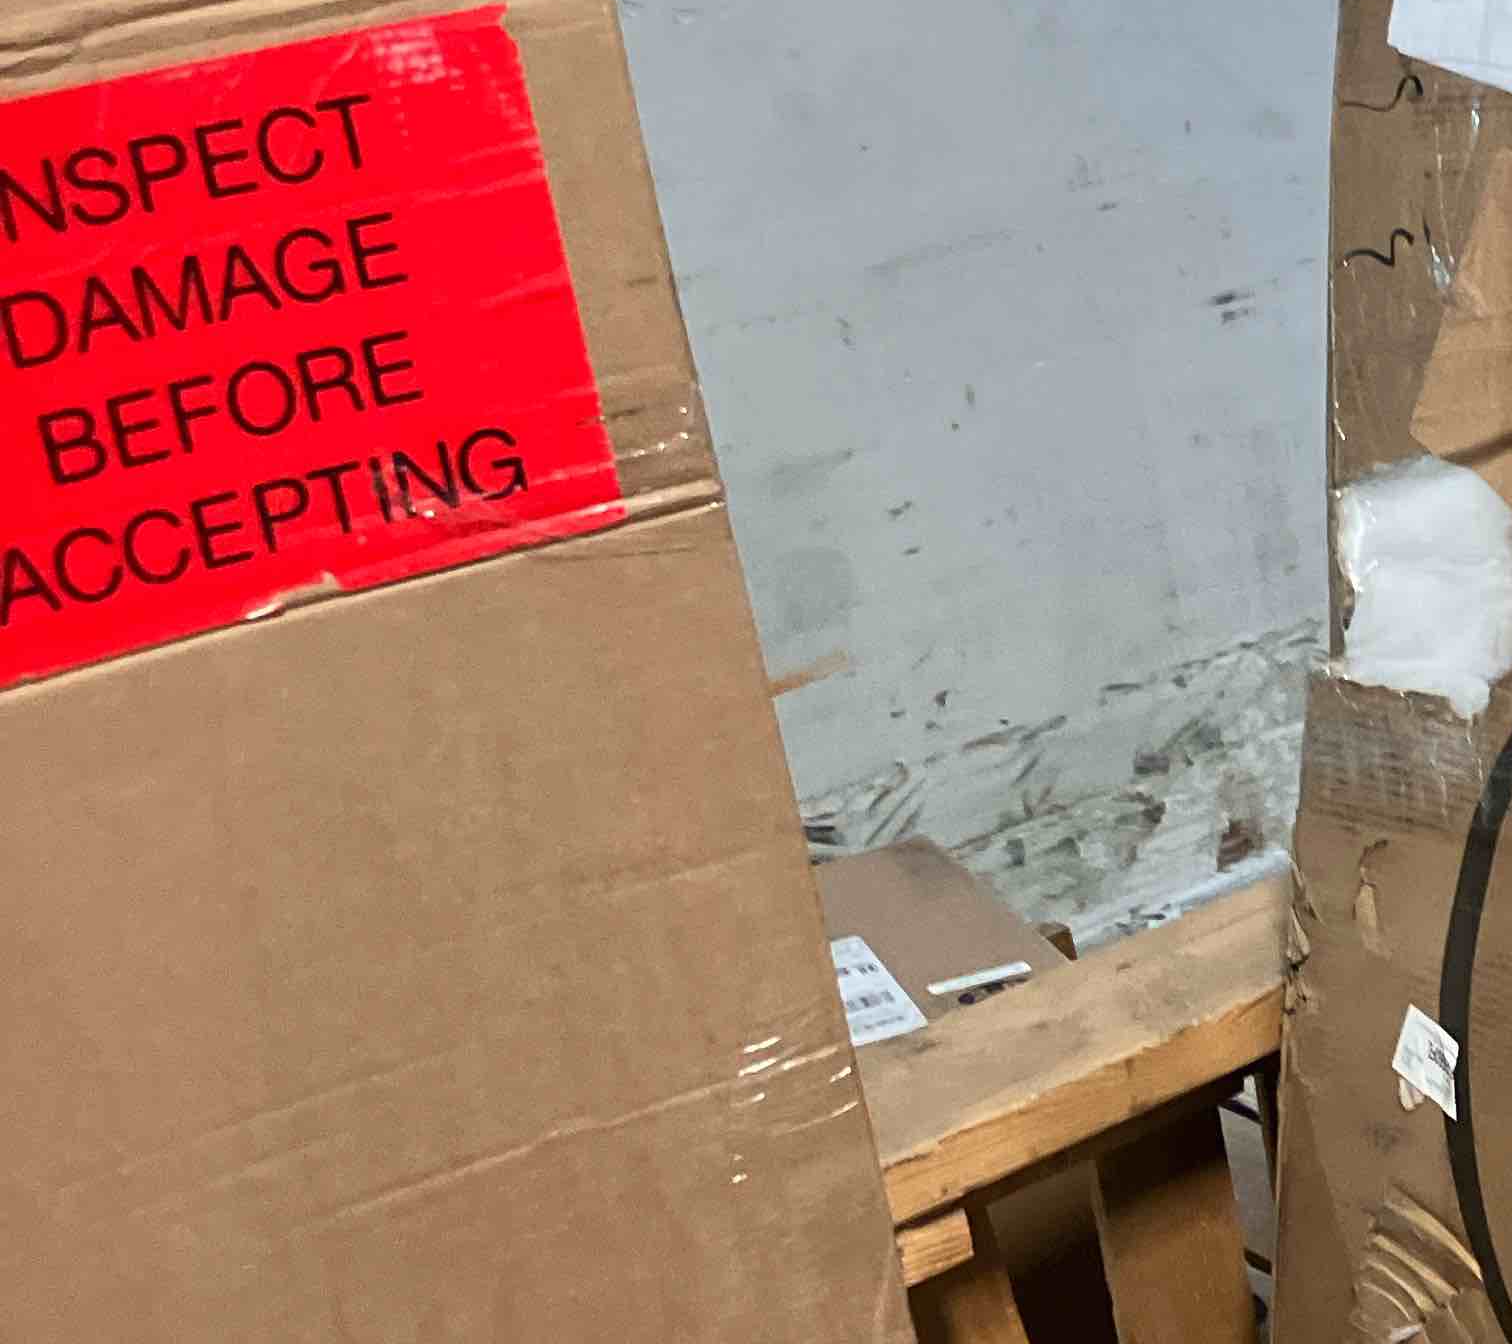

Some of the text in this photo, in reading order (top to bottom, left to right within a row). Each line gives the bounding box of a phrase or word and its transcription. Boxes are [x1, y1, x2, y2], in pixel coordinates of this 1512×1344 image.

[2, 211, 409, 369] DAMAGE
[37, 332, 425, 486] BEFORE
[0, 427, 530, 627] ACCEPTING
